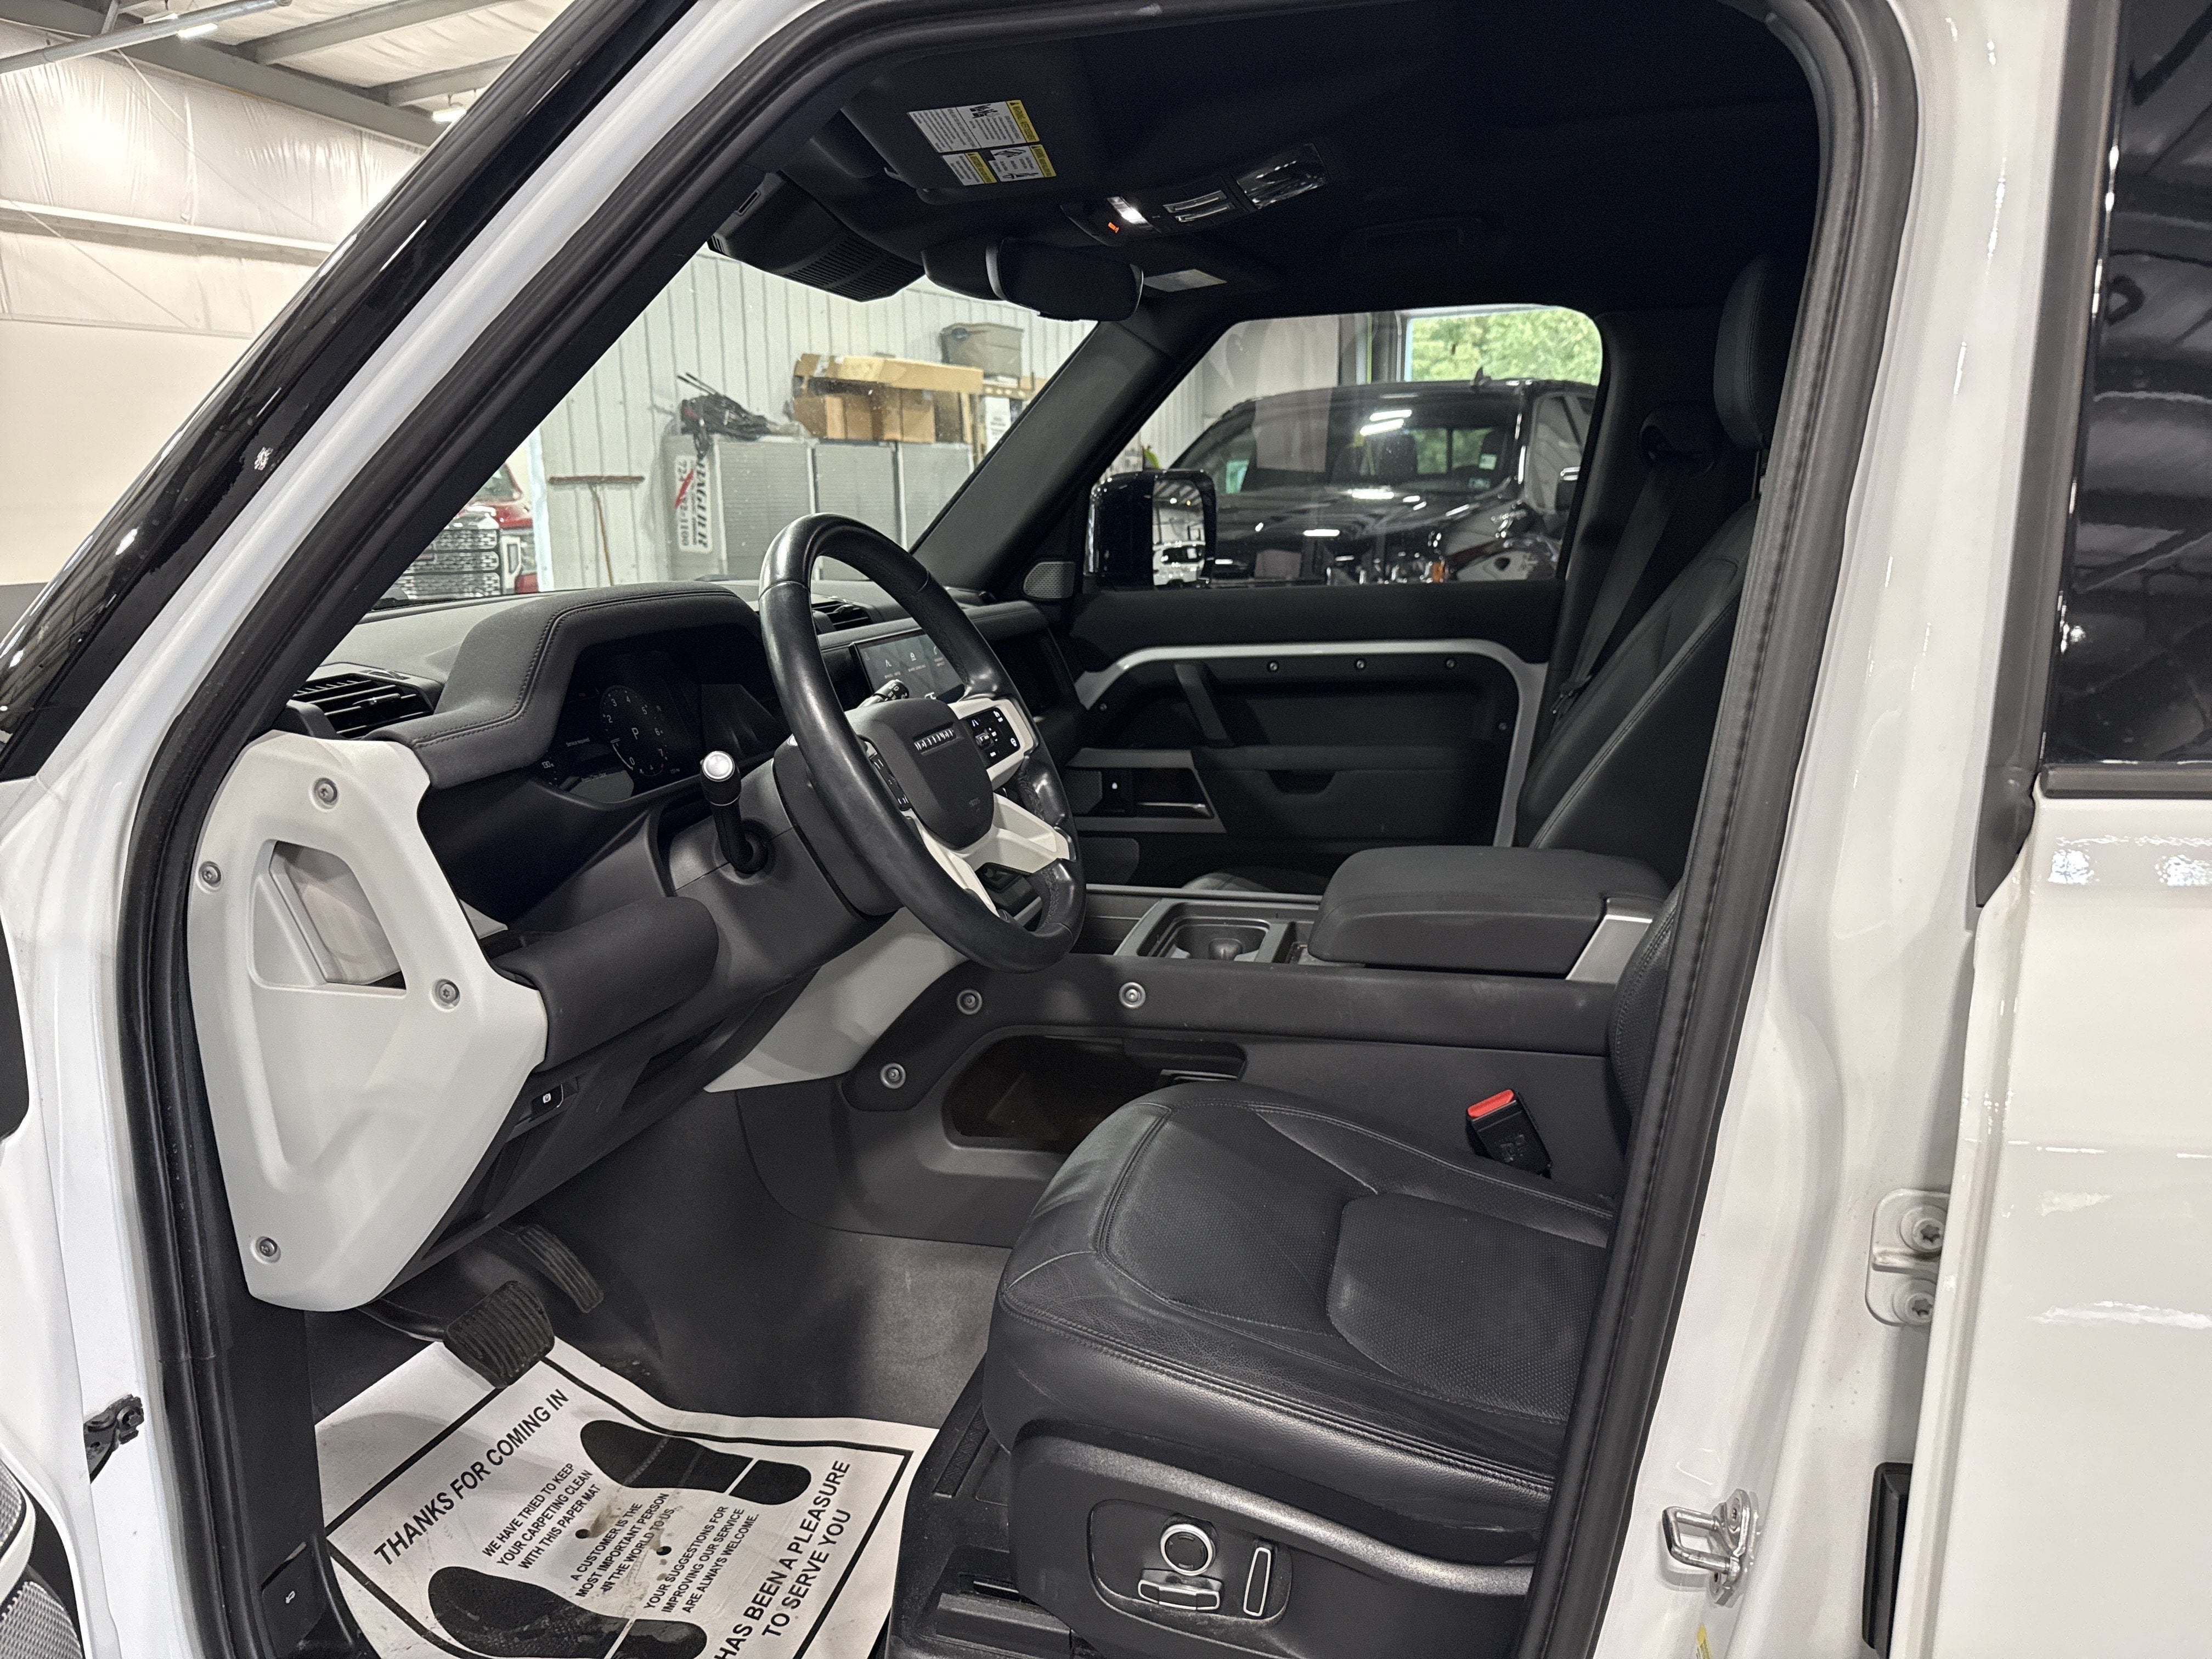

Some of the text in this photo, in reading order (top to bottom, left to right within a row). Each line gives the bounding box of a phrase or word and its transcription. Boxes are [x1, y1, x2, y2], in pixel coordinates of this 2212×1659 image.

[607, 715, 613, 723] 2
[611, 698, 617, 707] 3
[631, 727, 639, 740] P
[641, 707, 647, 715] 5
[629, 757, 635, 765] 0
[658, 749, 664, 757] 7
[374, 1389, 569, 1565] THANKS FOR COMING IN
[482, 1463, 574, 1557] WE HAVE TRIED TO KEEP
[496, 1470, 592, 1565] YOUR CARPETING CLEAN
[518, 1483, 601, 1569] WITH THIS PAPER MAT
[575, 1493, 669, 1597] MOST IMPORTANT PERSON
[577, 1528, 621, 1572] CUSTOMER
[615, 1519, 628, 1527] IS
[623, 1503, 643, 1517] THE
[600, 1581, 616, 1592] IN
[608, 1564, 630, 1580] THE
[624, 1532, 654, 1562] WORLD
[650, 1520, 664, 1531] TO
[644, 1506, 729, 1609] YOUR SUGGESTIONS FOR
[661, 1509, 744, 1612] IMPROVING OUR SERVICE
[682, 1514, 759, 1613] ARE ALWAYS WELCOME.
[714, 1460, 850, 1659] HAS BEEN A PLEASURE
[762, 1509, 851, 1636] TO SERVE YOU
